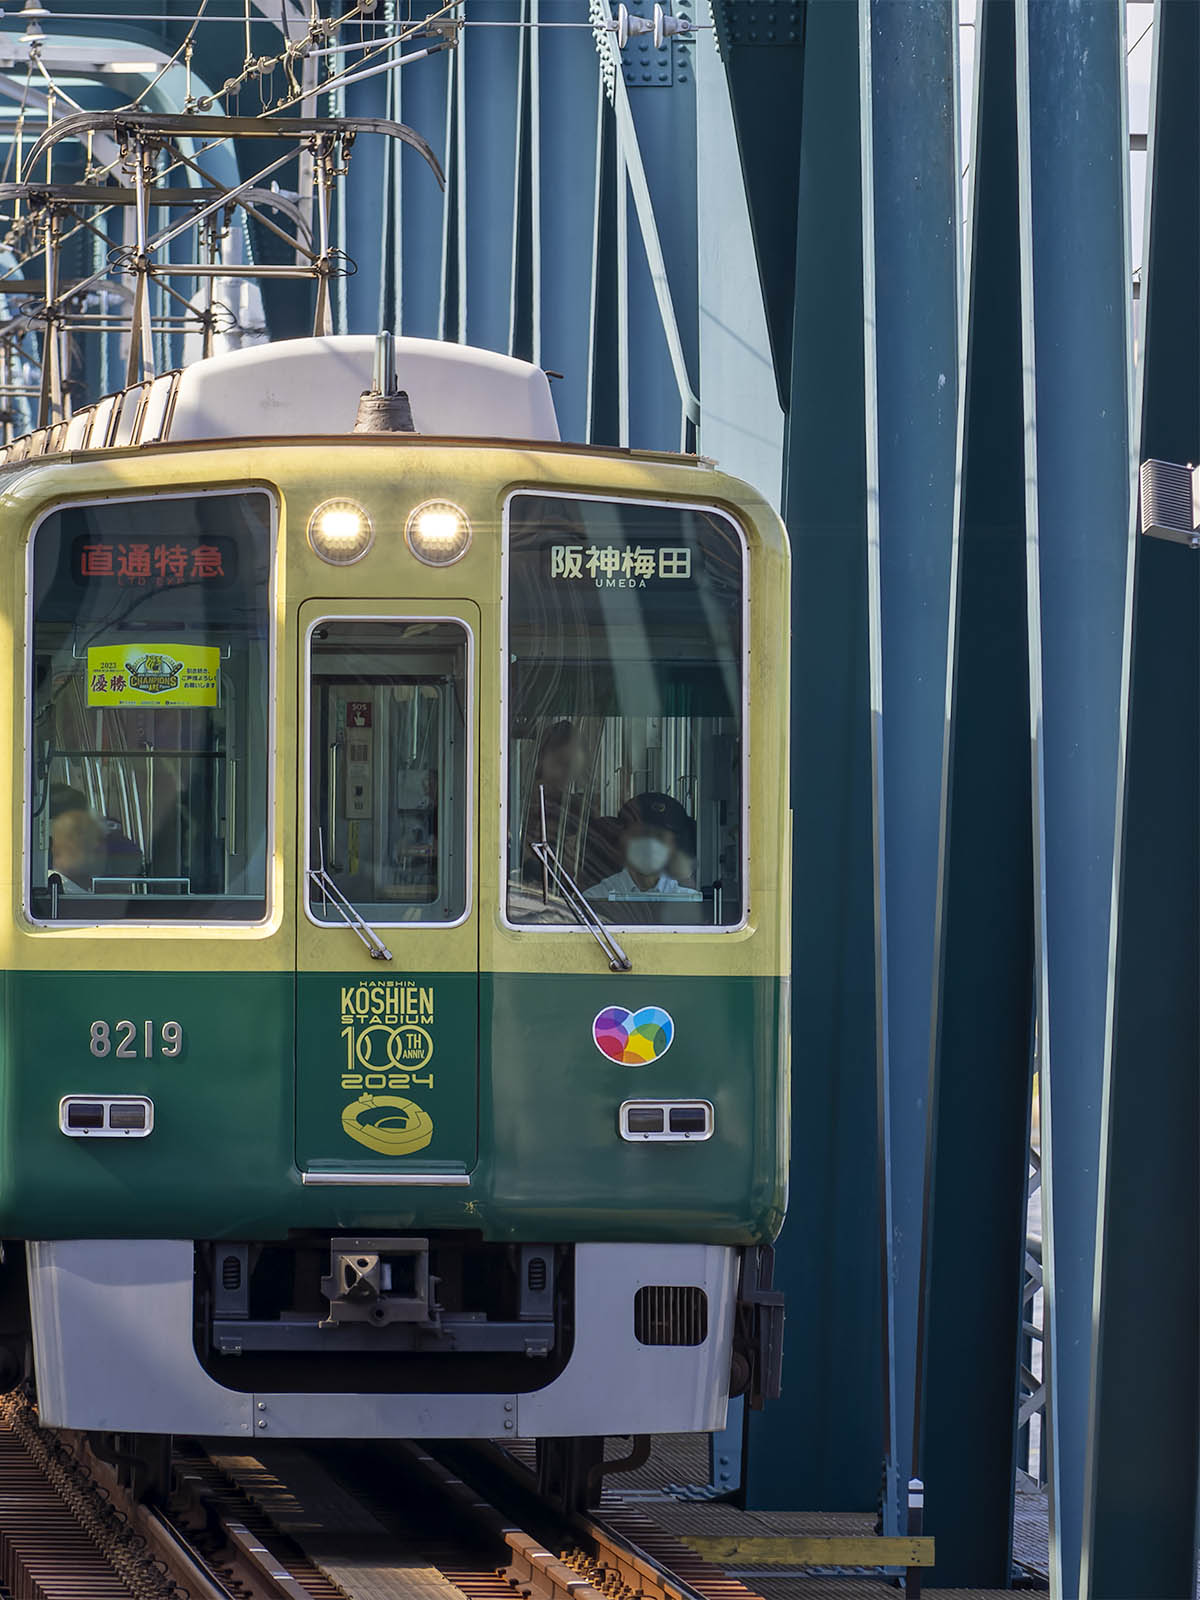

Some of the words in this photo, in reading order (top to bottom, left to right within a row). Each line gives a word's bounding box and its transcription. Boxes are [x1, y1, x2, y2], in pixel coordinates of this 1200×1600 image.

[81, 544, 225, 577] 直通特急
[551, 545, 691, 580] 阪神梅田
[595, 579, 647, 588] UMEDA
[90, 674, 127, 692] 優勝
[352, 703, 367, 711] SOS
[341, 987, 434, 1015] KOSHIEN
[341, 1015, 434, 1024] STADIUM
[89, 1020, 183, 1058] 8219
[341, 1073, 434, 1089] 2024
